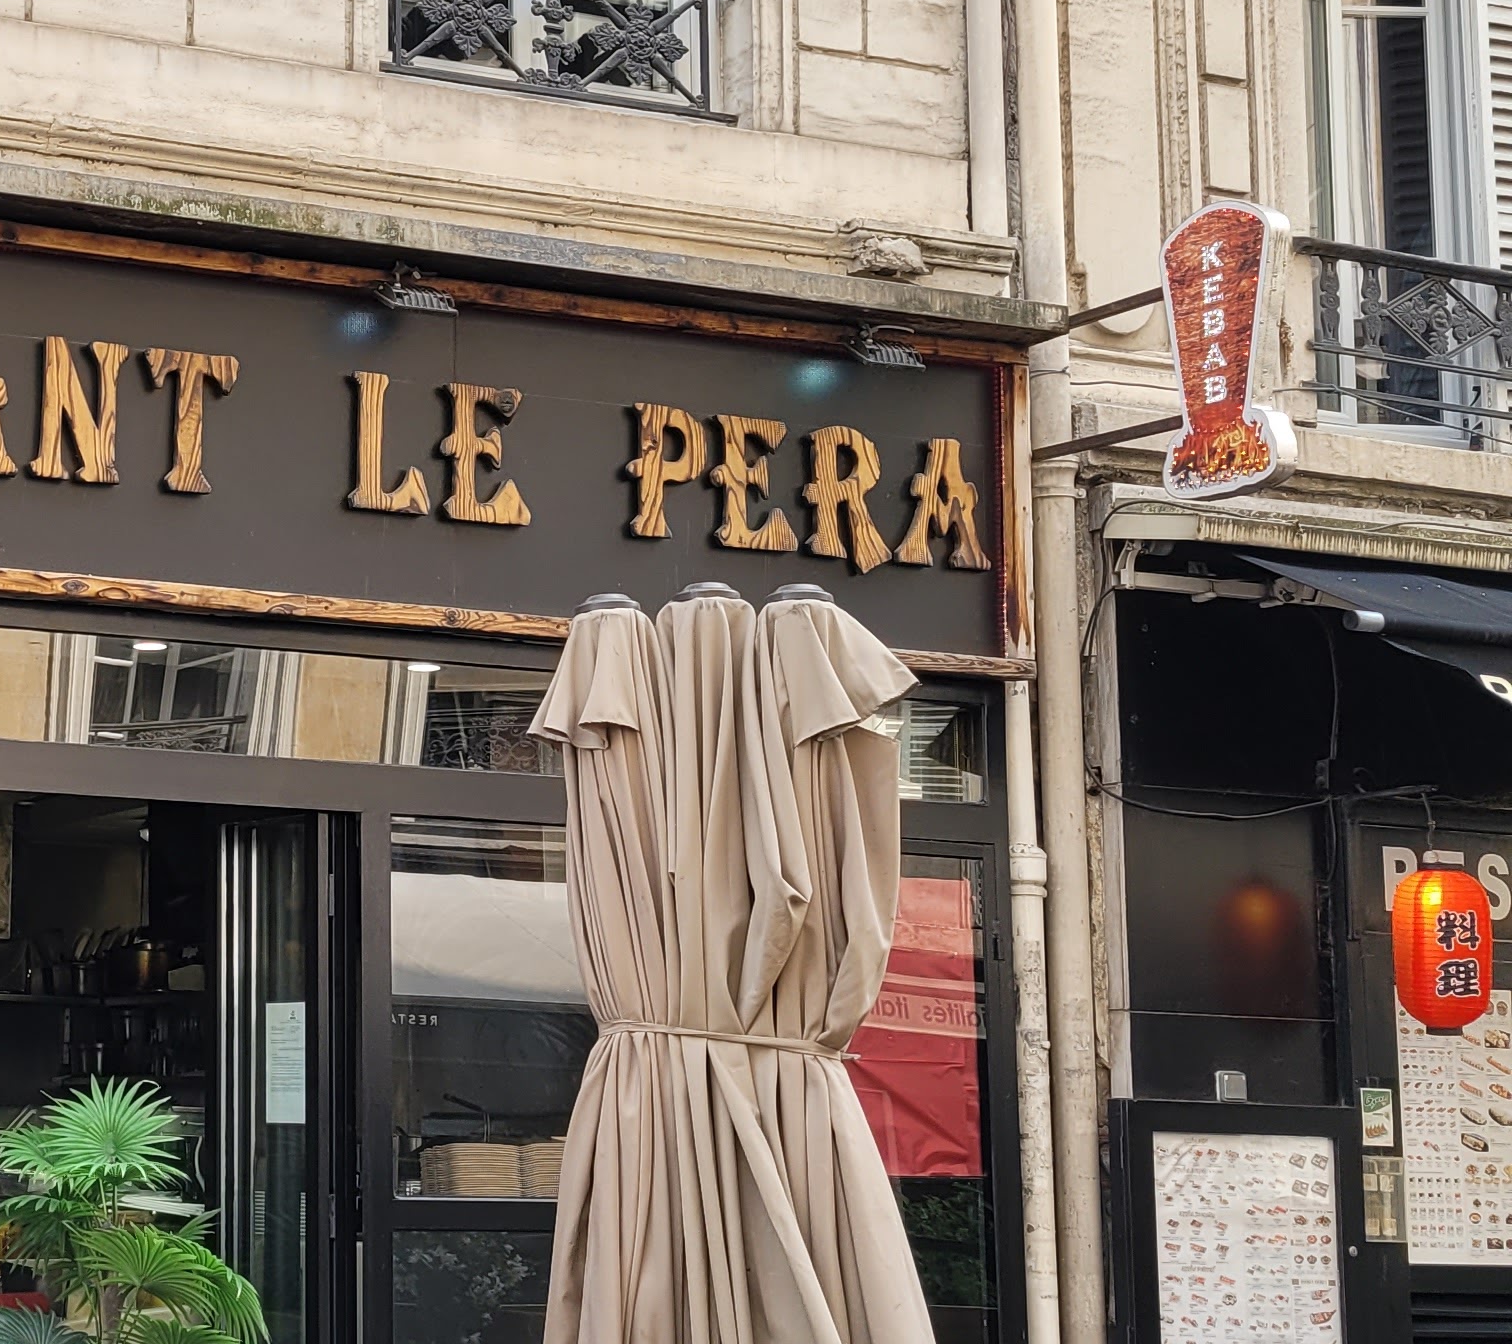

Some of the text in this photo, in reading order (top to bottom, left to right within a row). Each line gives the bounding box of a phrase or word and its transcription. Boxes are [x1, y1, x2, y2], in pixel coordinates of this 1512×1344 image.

[1200, 240, 1228, 405] KEBAB
[346, 369, 531, 526] LE
[626, 400, 992, 575] PERA
[1436, 910, 1480, 997] 料理
